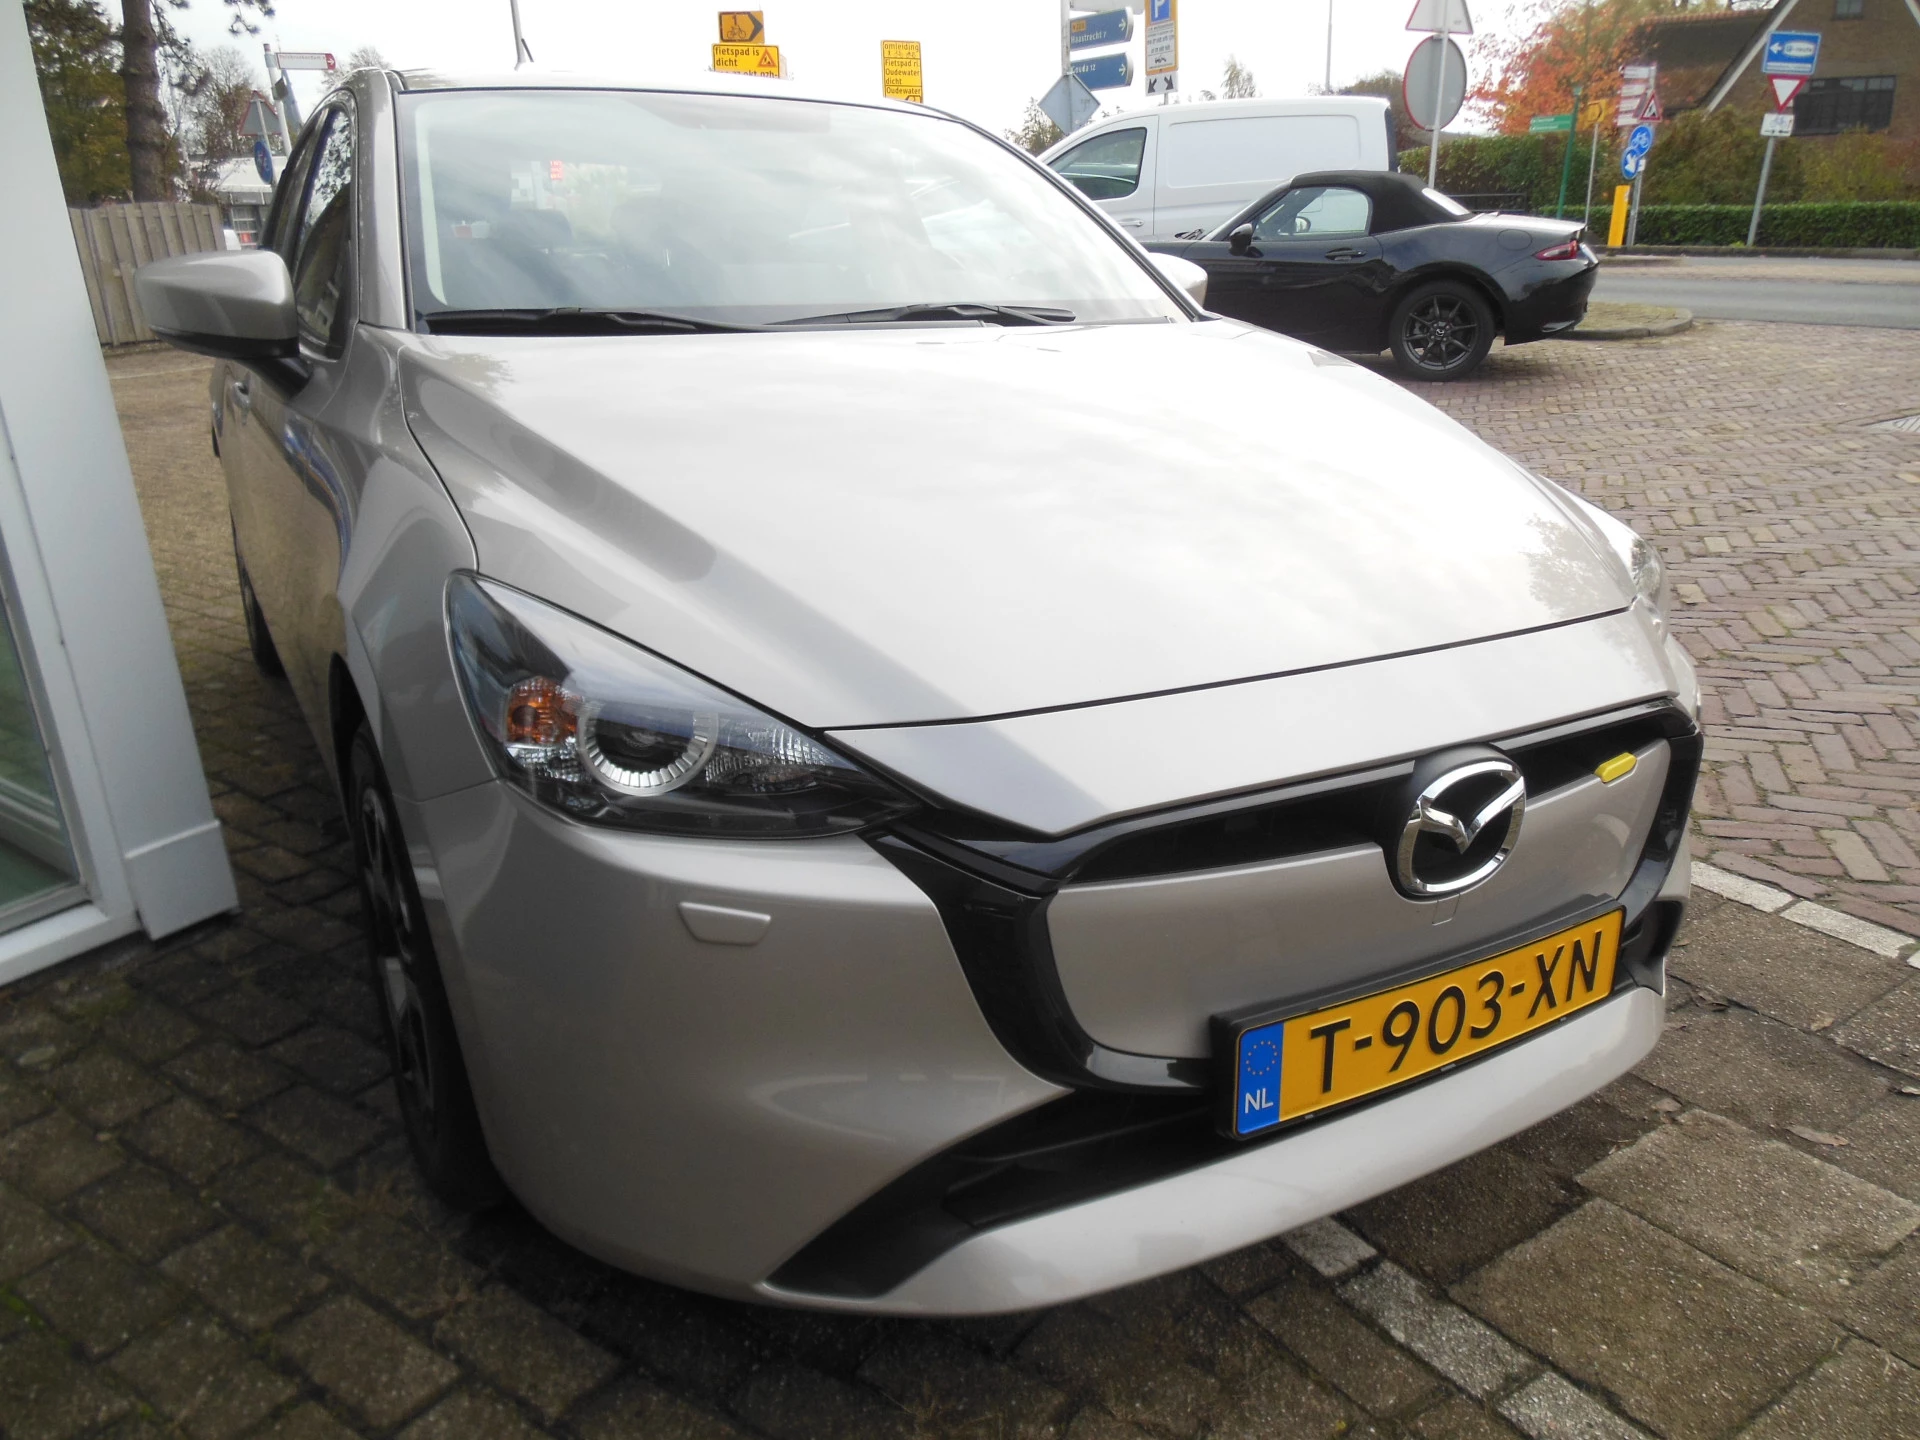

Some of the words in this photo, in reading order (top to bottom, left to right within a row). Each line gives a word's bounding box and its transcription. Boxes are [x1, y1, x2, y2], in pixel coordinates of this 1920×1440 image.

[732, 15, 737, 26] 1
[1071, 31, 1102, 43] Haastrecht
[752, 47, 760, 56] is
[885, 43, 919, 52] omleiding
[716, 58, 738, 67] dicht
[886, 59, 912, 68] Fietspad
[1090, 63, 1096, 71] 12
[885, 68, 920, 76] Oudewater
[887, 87, 920, 95] Oudewater
[1310, 930, 1603, 1093] T-903-XN
[1244, 1087, 1274, 1115] NL
